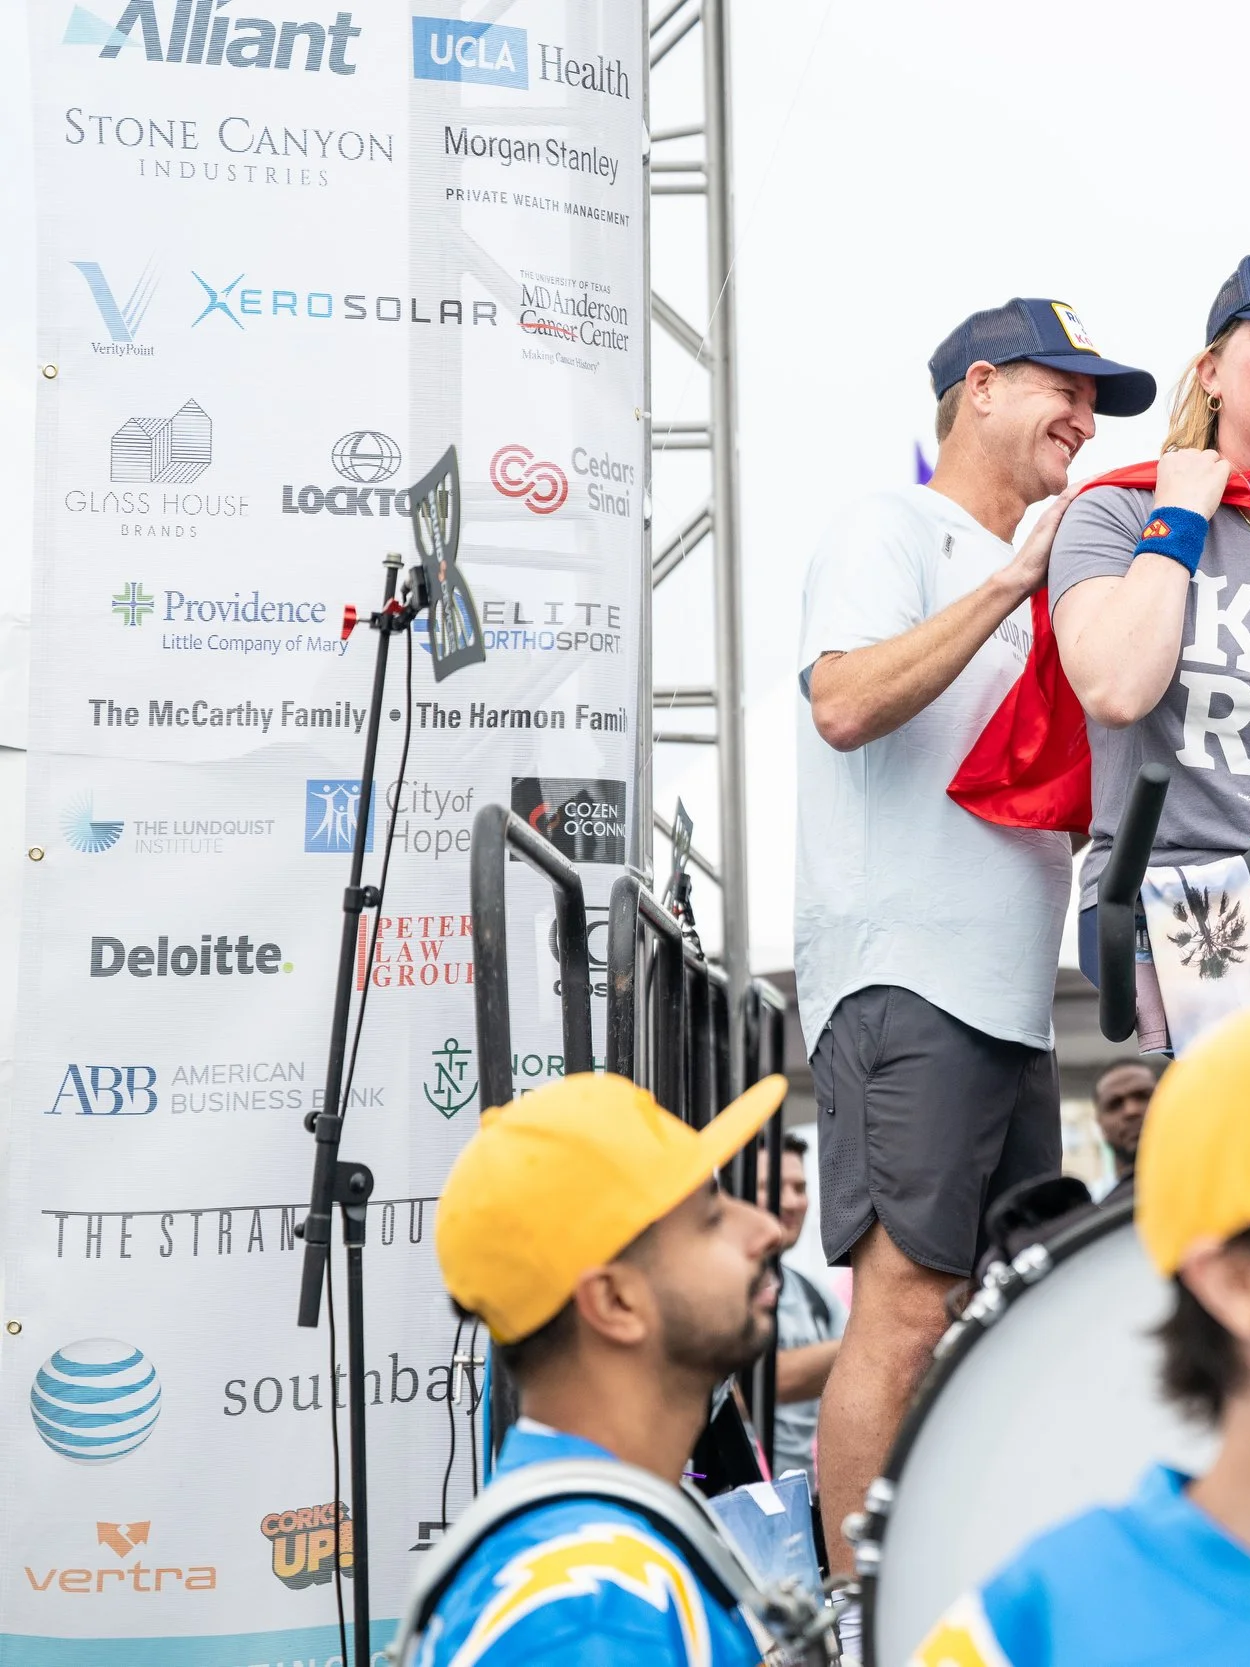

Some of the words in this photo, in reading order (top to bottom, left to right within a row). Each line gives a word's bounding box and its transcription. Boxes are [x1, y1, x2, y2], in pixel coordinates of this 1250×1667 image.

[98, 0, 362, 75] Alliant
[430, 33, 516, 73] UCLA
[538, 43, 630, 100] Health
[65, 107, 199, 150] STONE
[218, 116, 394, 163] CANYON
[445, 126, 540, 167] Morgan
[546, 138, 619, 186] Stanley
[138, 159, 329, 187] INDUSTRIES
[446, 188, 508, 205] PRIVATE
[513, 193, 559, 212] WEALTH
[564, 202, 630, 228] MANAGEMENT
[520, 269, 534, 280] THE
[536, 273, 577, 288] UNIVERSITY
[579, 280, 589, 290] OF
[591, 282, 611, 295] TEXAS
[519, 309, 578, 343] Cancer
[580, 320, 629, 352] Center
[91, 342, 155, 357] VerityPoint
[521, 348, 555, 365] Making
[571, 446, 635, 487] Cedars
[65, 489, 150, 514] GLASS
[163, 493, 249, 517] HOUSE
[587, 482, 631, 518] Sinai
[120, 524, 198, 538] BRANDS
[162, 590, 327, 624] Providence
[482, 601, 621, 629] ELITE
[162, 634, 203, 651] Little
[207, 635, 281, 656] Company
[285, 634, 303, 652] of
[306, 636, 349, 657] Mary
[483, 630, 621, 654] ORTHOSPORT
[88, 699, 140, 727] The
[148, 700, 274, 734] McCarthy
[281, 700, 367, 735] Family
[416, 702, 462, 729] The
[469, 702, 566, 730] Harmon
[575, 704, 628, 733] Famil
[385, 778, 451, 821] City
[452, 787, 474, 813] of
[564, 802, 618, 819] COZEN
[133, 820, 169, 836] THE
[173, 819, 275, 836] LUNDQUIST
[386, 819, 472, 860] Hope
[564, 818, 626, 837] O'CONN
[134, 838, 225, 854] INSTITUTE
[374, 940, 445, 964] LAW
[44, 1063, 158, 1116] ABB
[171, 1061, 305, 1087] AMERICAN
[171, 1088, 303, 1115] BUSINESS
[54, 1212, 133, 1259] THE
[159, 1207, 297, 1258] STRAN
[24, 1560, 217, 1594] vertra
